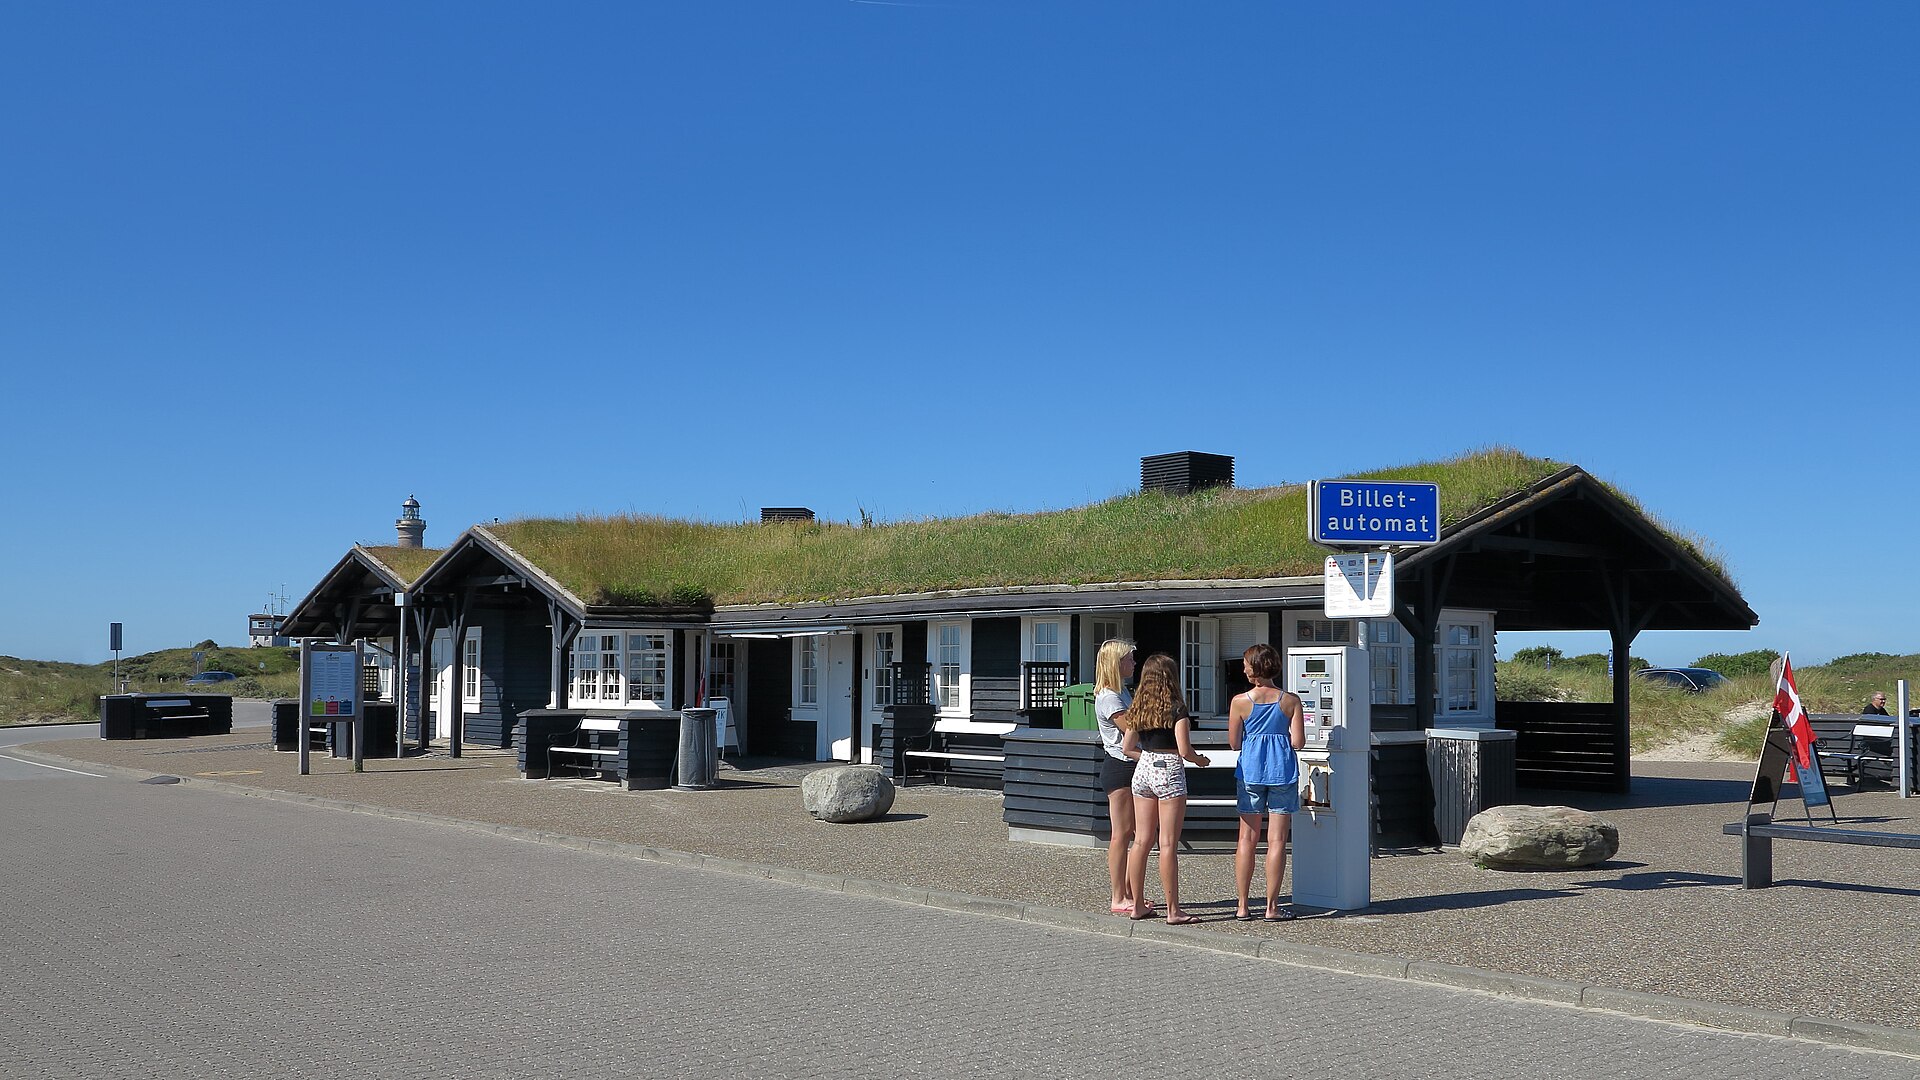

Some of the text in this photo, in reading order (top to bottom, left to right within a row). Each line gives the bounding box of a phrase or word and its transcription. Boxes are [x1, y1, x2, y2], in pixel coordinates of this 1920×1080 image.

[1340, 489, 1416, 508] Billet-
[1327, 513, 1429, 533] automat
[1323, 685, 1331, 693] 13
